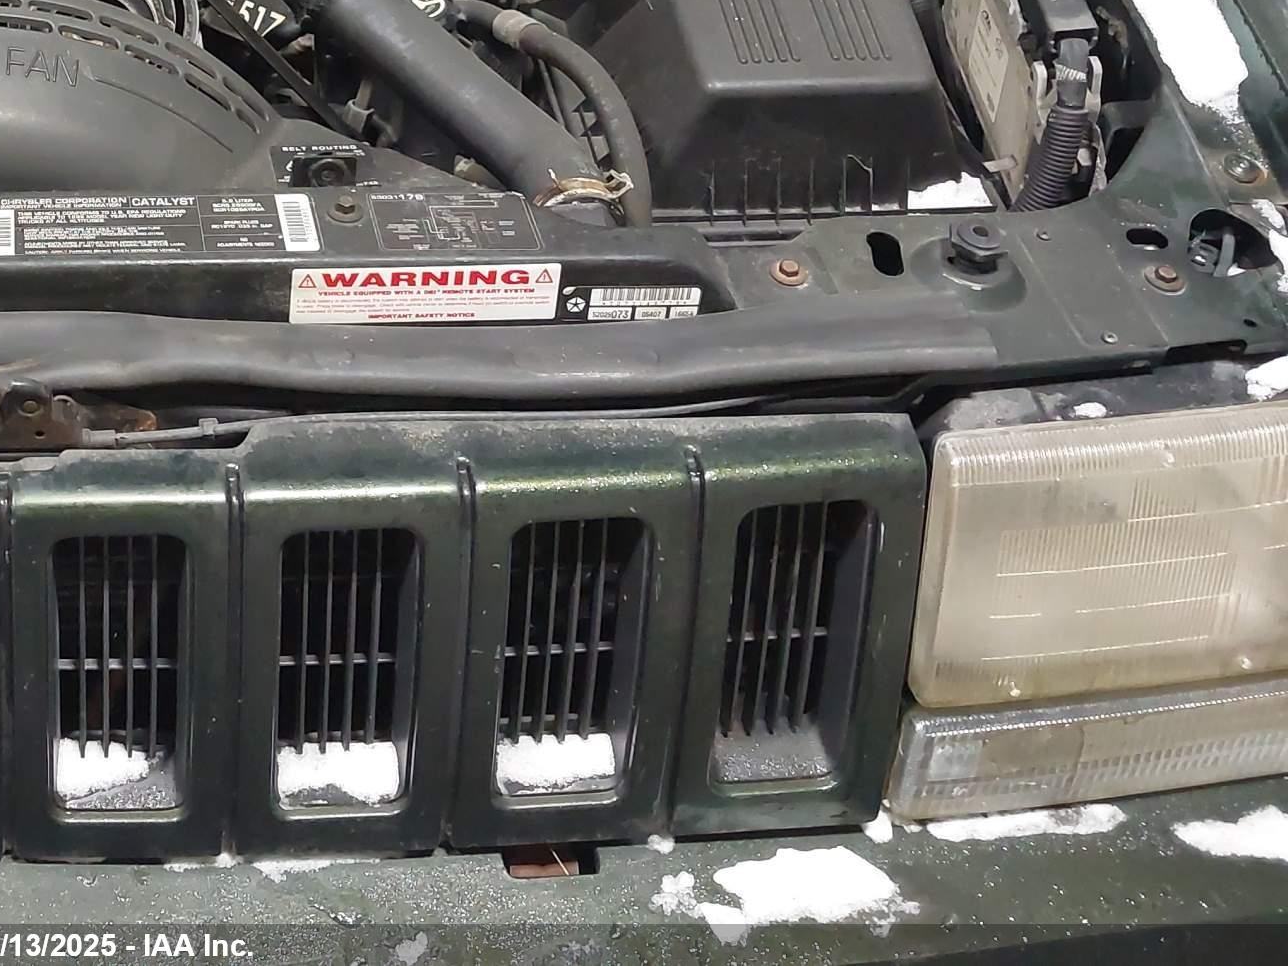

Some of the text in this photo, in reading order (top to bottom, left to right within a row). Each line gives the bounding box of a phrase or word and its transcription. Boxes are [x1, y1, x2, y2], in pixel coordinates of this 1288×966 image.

[4, 46, 82, 88] FAN
[131, 197, 196, 207] CATALYST
[322, 269, 531, 288] WARNING
